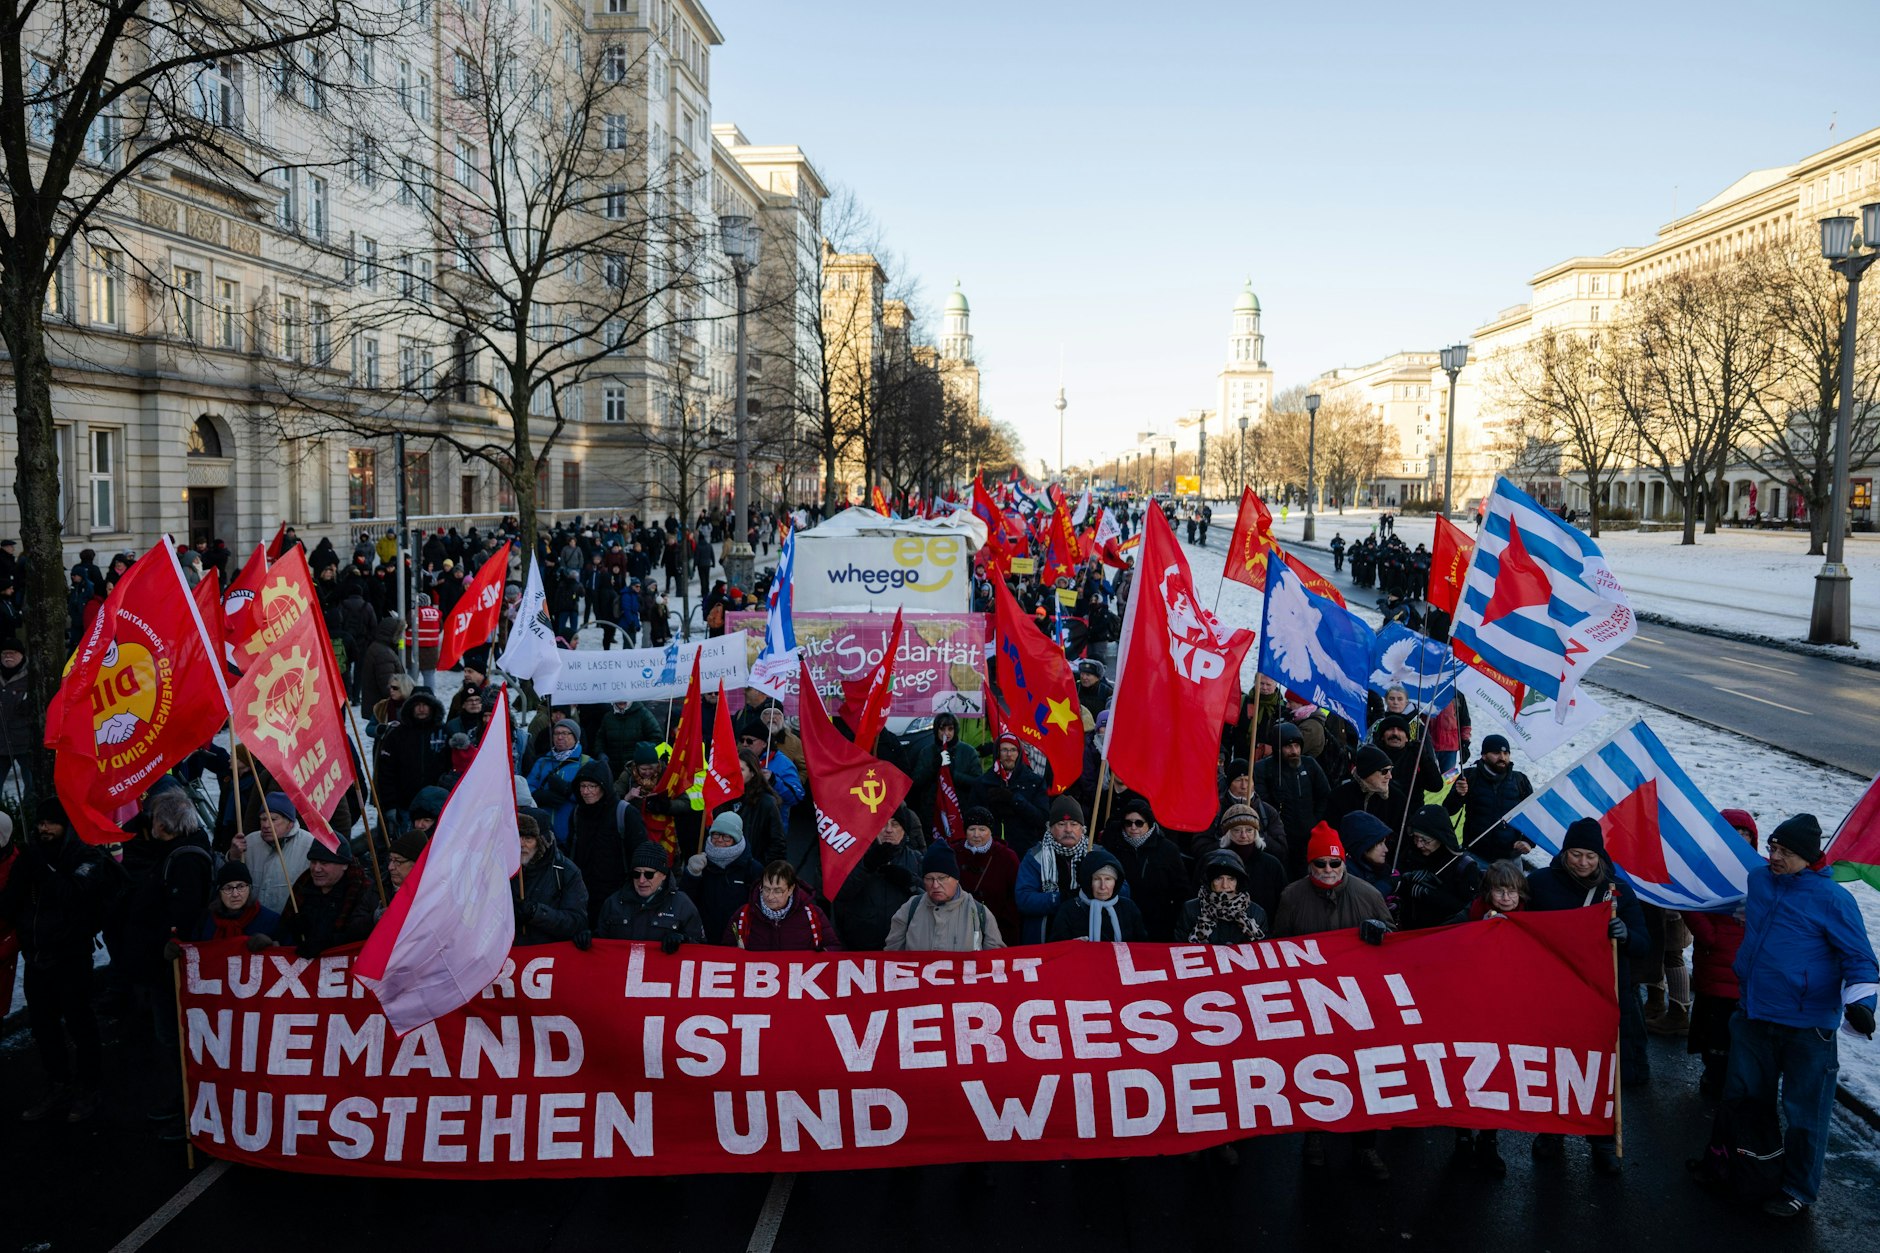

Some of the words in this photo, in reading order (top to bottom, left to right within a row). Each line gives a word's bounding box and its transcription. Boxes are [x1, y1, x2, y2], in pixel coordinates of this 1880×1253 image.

[828, 563, 919, 588] wheego
[568, 660, 582, 670] WIR
[588, 659, 622, 670] LASSEN
[627, 658, 645, 668] UNS
[680, 645, 725, 663] BELGEN!
[836, 630, 980, 674] Soldarität
[556, 680, 588, 692] SCHLUSS
[592, 682, 606, 691] MIT
[612, 681, 627, 690] DEN
[184, 943, 555, 999] LUXERG
[625, 943, 1043, 1000] LIEBKNECHT
[1113, 939, 1328, 986] LENIN
[186, 1008, 585, 1079] NIEMAND
[643, 1014, 771, 1079] IST
[189, 1081, 655, 1163] AUFSTEHEN
[714, 1087, 909, 1155] UND
[961, 1042, 1616, 1142] WIDERSETZEN!
